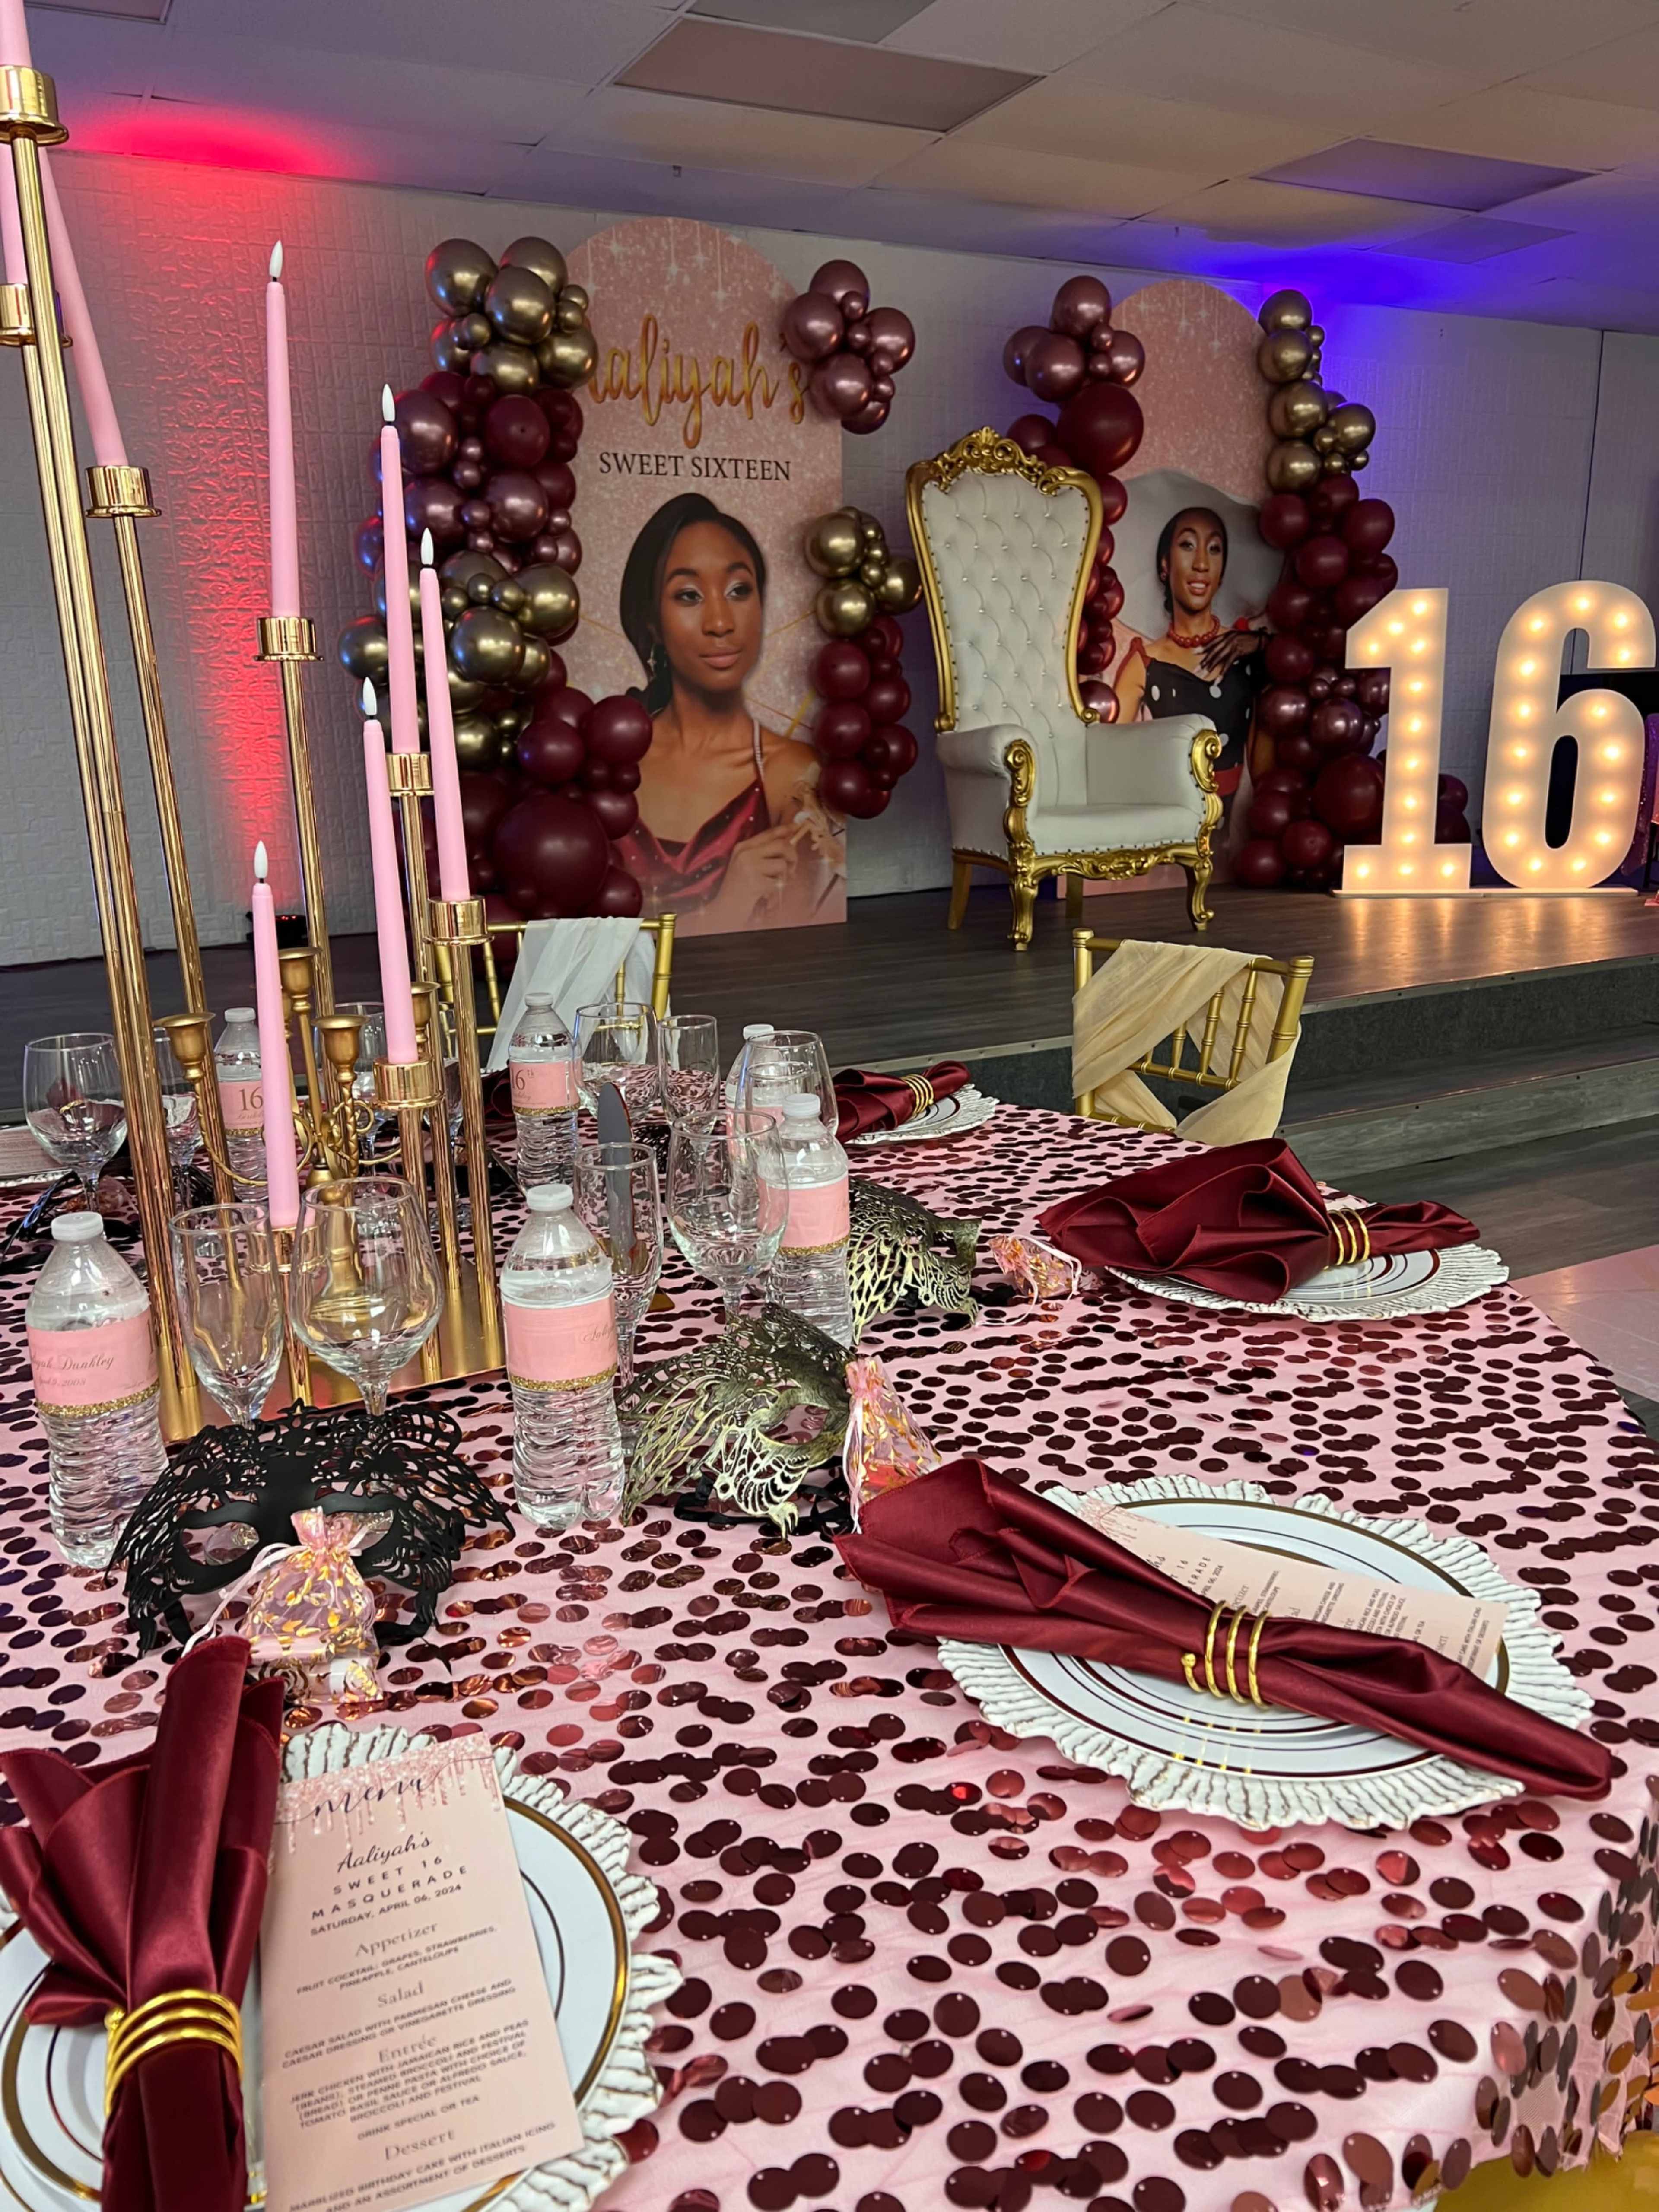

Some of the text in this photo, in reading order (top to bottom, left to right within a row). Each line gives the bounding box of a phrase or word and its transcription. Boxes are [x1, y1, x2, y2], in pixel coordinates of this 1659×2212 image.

[587, 314, 810, 448] aliyah's
[599, 451, 791, 481] SWEET SIXTEEN
[1342, 580, 1656, 889] 16
[238, 1086, 264, 1111] 16
[1176, 1560, 1188, 1570] 16
[1201, 1584, 1212, 1595] PRIL
[333, 1856, 442, 1895] SWEET 16
[337, 1832, 432, 1873] Aaliyah's
[310, 1911, 375, 1936] SATURDAY,
[378, 1901, 410, 1915] APRIL
[435, 1884, 461, 1897] 2024
[312, 1866, 467, 1920] MASQUERADE
[355, 1923, 438, 1957] Appetizer
[297, 1980, 324, 1995] FRUIT
[378, 1980, 423, 2008] Salad
[282, 2050, 323, 2069] CAESAR
[326, 2033, 377, 2054] DRESSING
[380, 2027, 395, 2036] OR
[467, 1986, 516, 2008] DRESSING
[284, 1978, 512, 2059] CAESAR SALAD WITH PARMESAN CHEESE AND
[291, 2019, 529, 2103] JERK CHICKEN WITH JAMAICAN RICE AND PEAS
[348, 2073, 397, 2094] STEAMED
[400, 2054, 453, 2077] BROCCOLI
[456, 2046, 479, 2059] AND
[481, 2031, 527, 2050] FESTIVAL
[348, 2094, 363, 2104] OR
[367, 2081, 401, 2098] PENNE
[404, 2069, 438, 2085] PASTA
[440, 2059, 467, 2073] WITH
[470, 2045, 509, 2063] CHOICE
[512, 2040, 525, 2050] OF
[379, 2034, 437, 2063] Entrée
[300, 2108, 346, 2129] TOMATO
[350, 2098, 377, 2113] BASIL
[383, 2085, 417, 2101] SAUCE
[420, 2080, 437, 2090] OR
[440, 2063, 487, 2083] ALFREDO
[350, 2075, 482, 2123] BROCCOLI AND FESTIVAL
[357, 2094, 480, 2141] DRINK SPECIAL OR TEA
[357, 2169, 414, 2193] BIRTHDAY
[416, 2158, 445, 2174] CAKE
[448, 2148, 477, 2163] WITH
[480, 2133, 522, 2154] ITALIAN
[525, 2121, 556, 2138] ICING
[385, 2129, 455, 2161] Dessert
[354, 2195, 372, 2206] AN
[375, 2170, 450, 2199] ASSORTMENT
[453, 2163, 469, 2175] OF
[471, 2144, 526, 2169] DESSERTS
